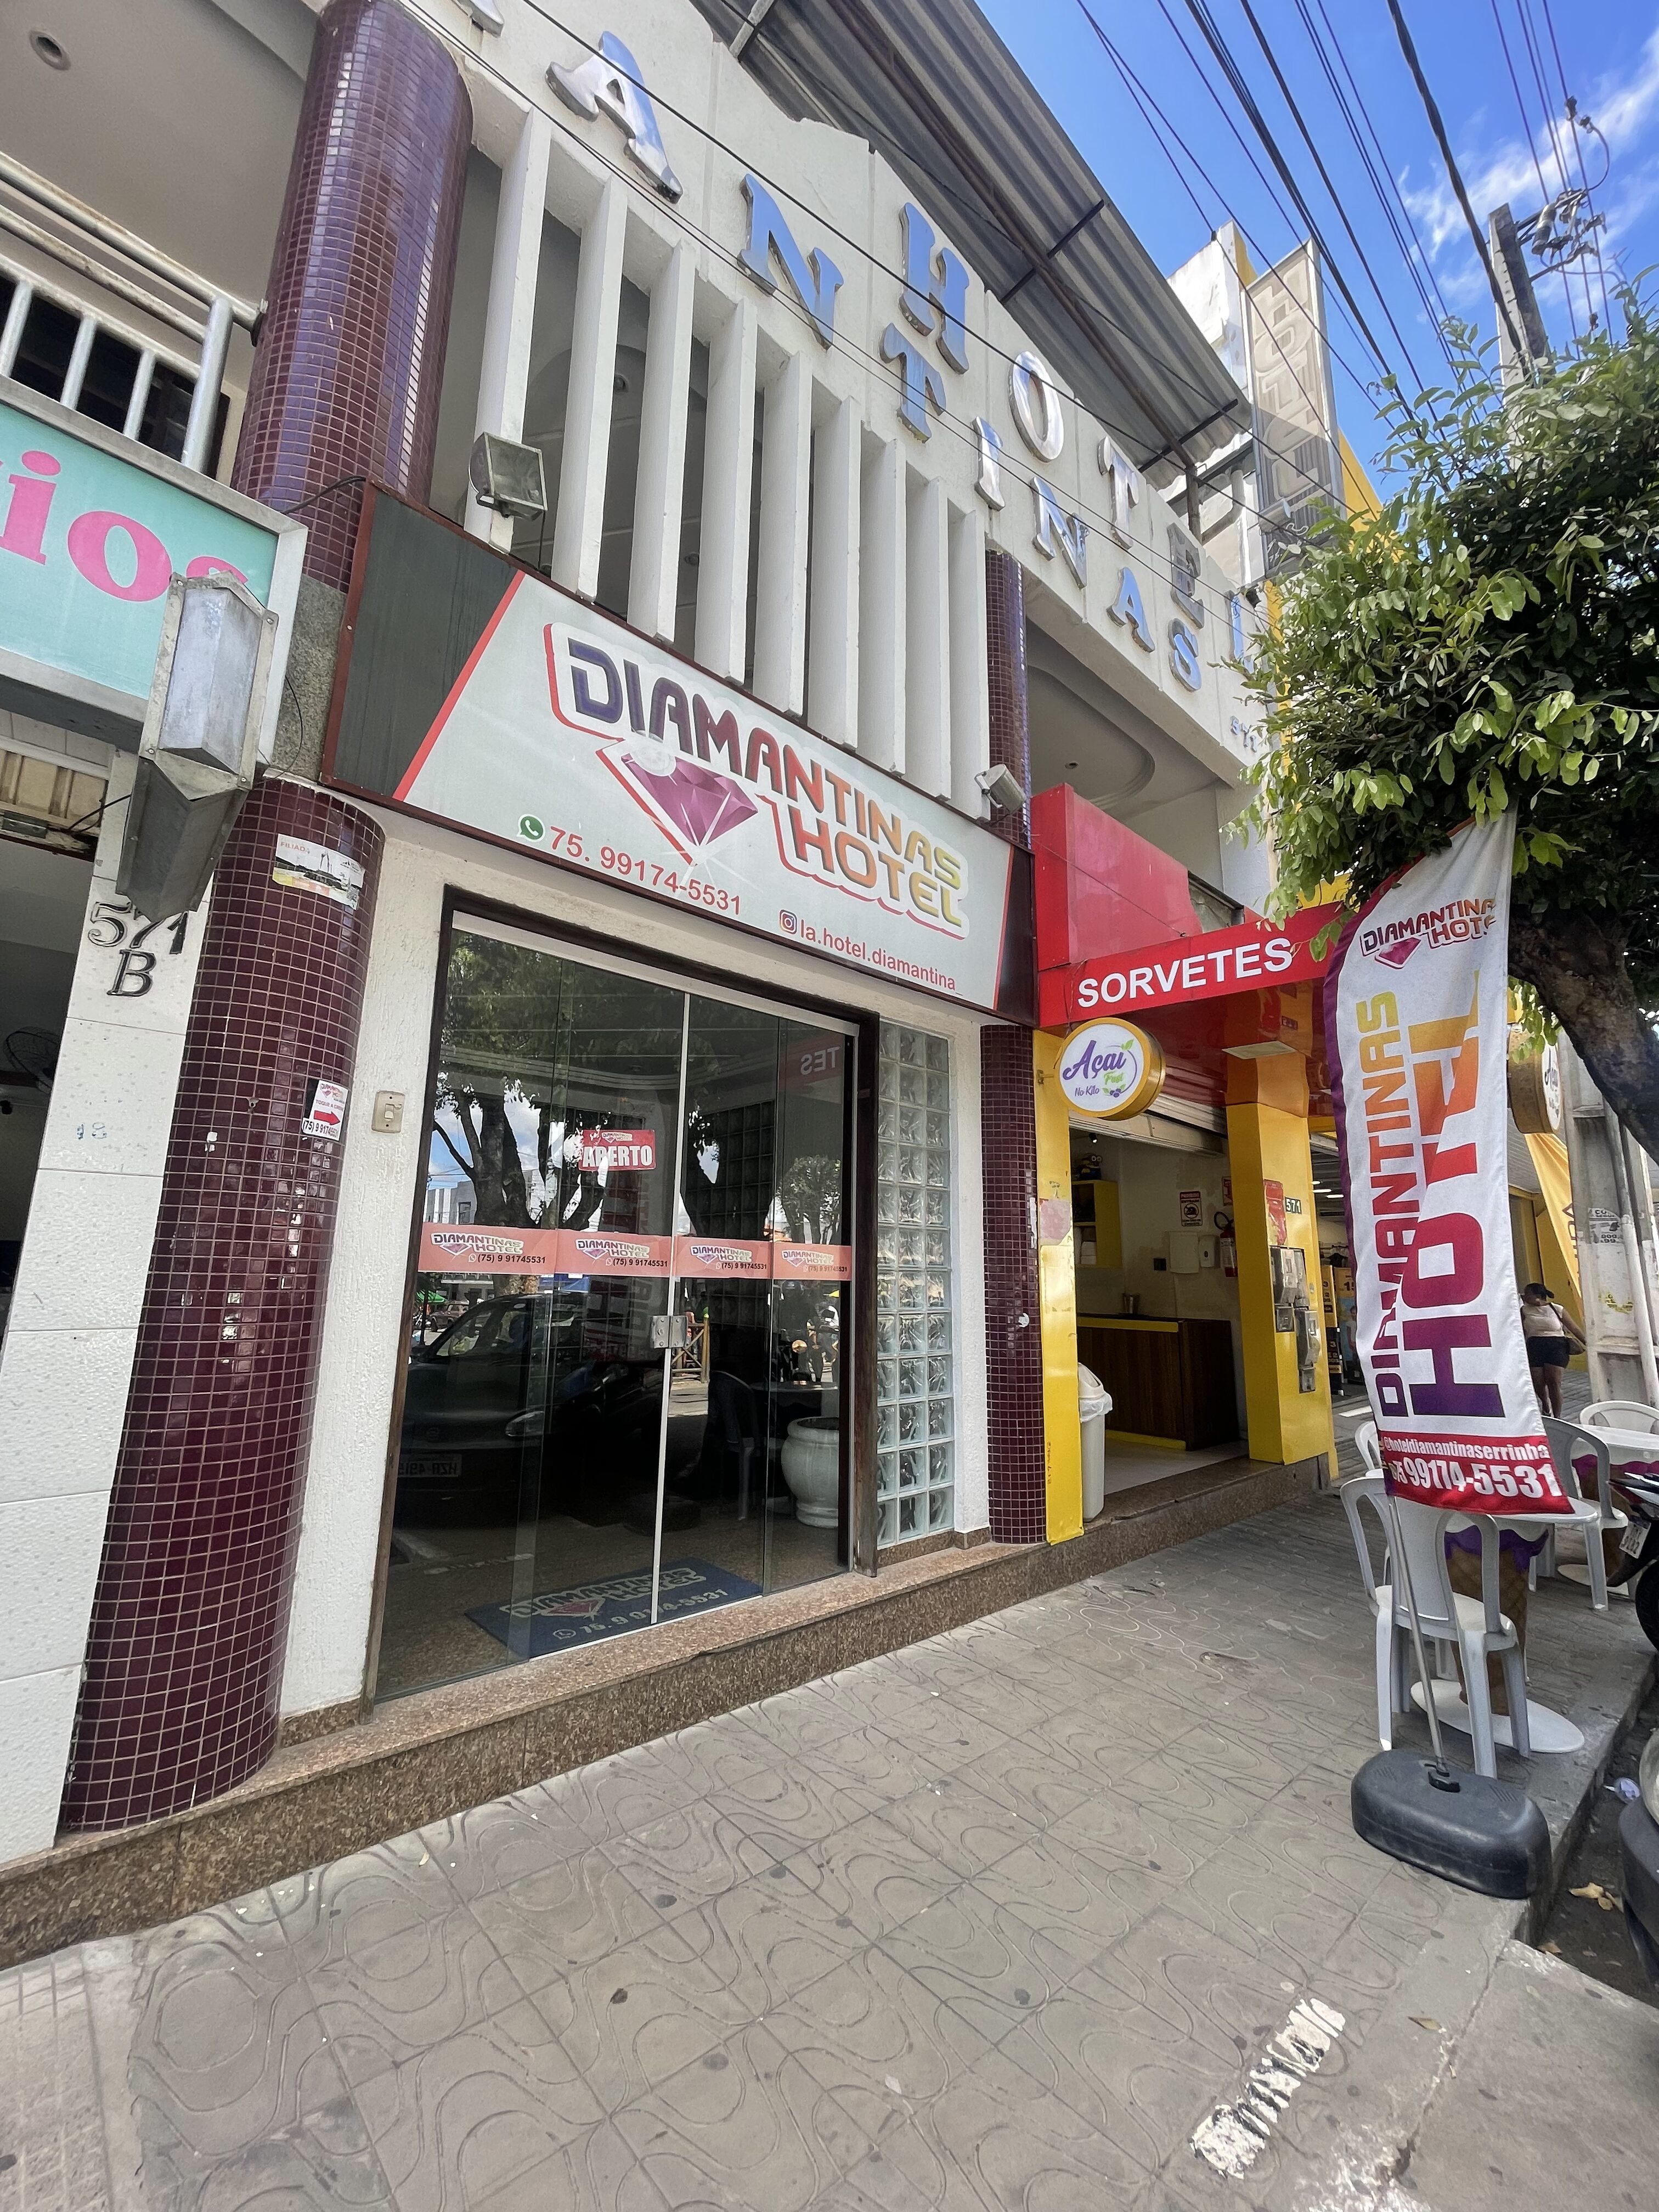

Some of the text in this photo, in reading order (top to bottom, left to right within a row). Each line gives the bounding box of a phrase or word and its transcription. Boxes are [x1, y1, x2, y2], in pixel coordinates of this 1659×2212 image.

[567, 637, 962, 890] DIAMANTINAS
[787, 804, 962, 927] HOTEL
[600, 849, 742, 916] 99174-5531
[107, 949, 157, 996] B
[1077, 936, 1294, 1008] SORVETES
[1075, 1085, 1099, 1097] No Kilo
[303, 1120, 314, 1133] (75)
[315, 1123, 319, 1132] 9
[582, 1145, 653, 1167] ABERTO
[1286, 1198, 1301, 1213] 571
[433, 1234, 522, 1247] DIAMANTINAS
[578, 1240, 648, 1253] DIAMANTINAS
[476, 1244, 522, 1254] HOTEL
[612, 1249, 648, 1257] HOTEL
[478, 1254, 494, 1263] (75)
[505, 1255, 546, 1263] 91745531
[613, 1258, 627, 1267] (75)
[635, 1259, 668, 1267] 91745531
[1403, 1457, 1562, 1498] 99174-5531
